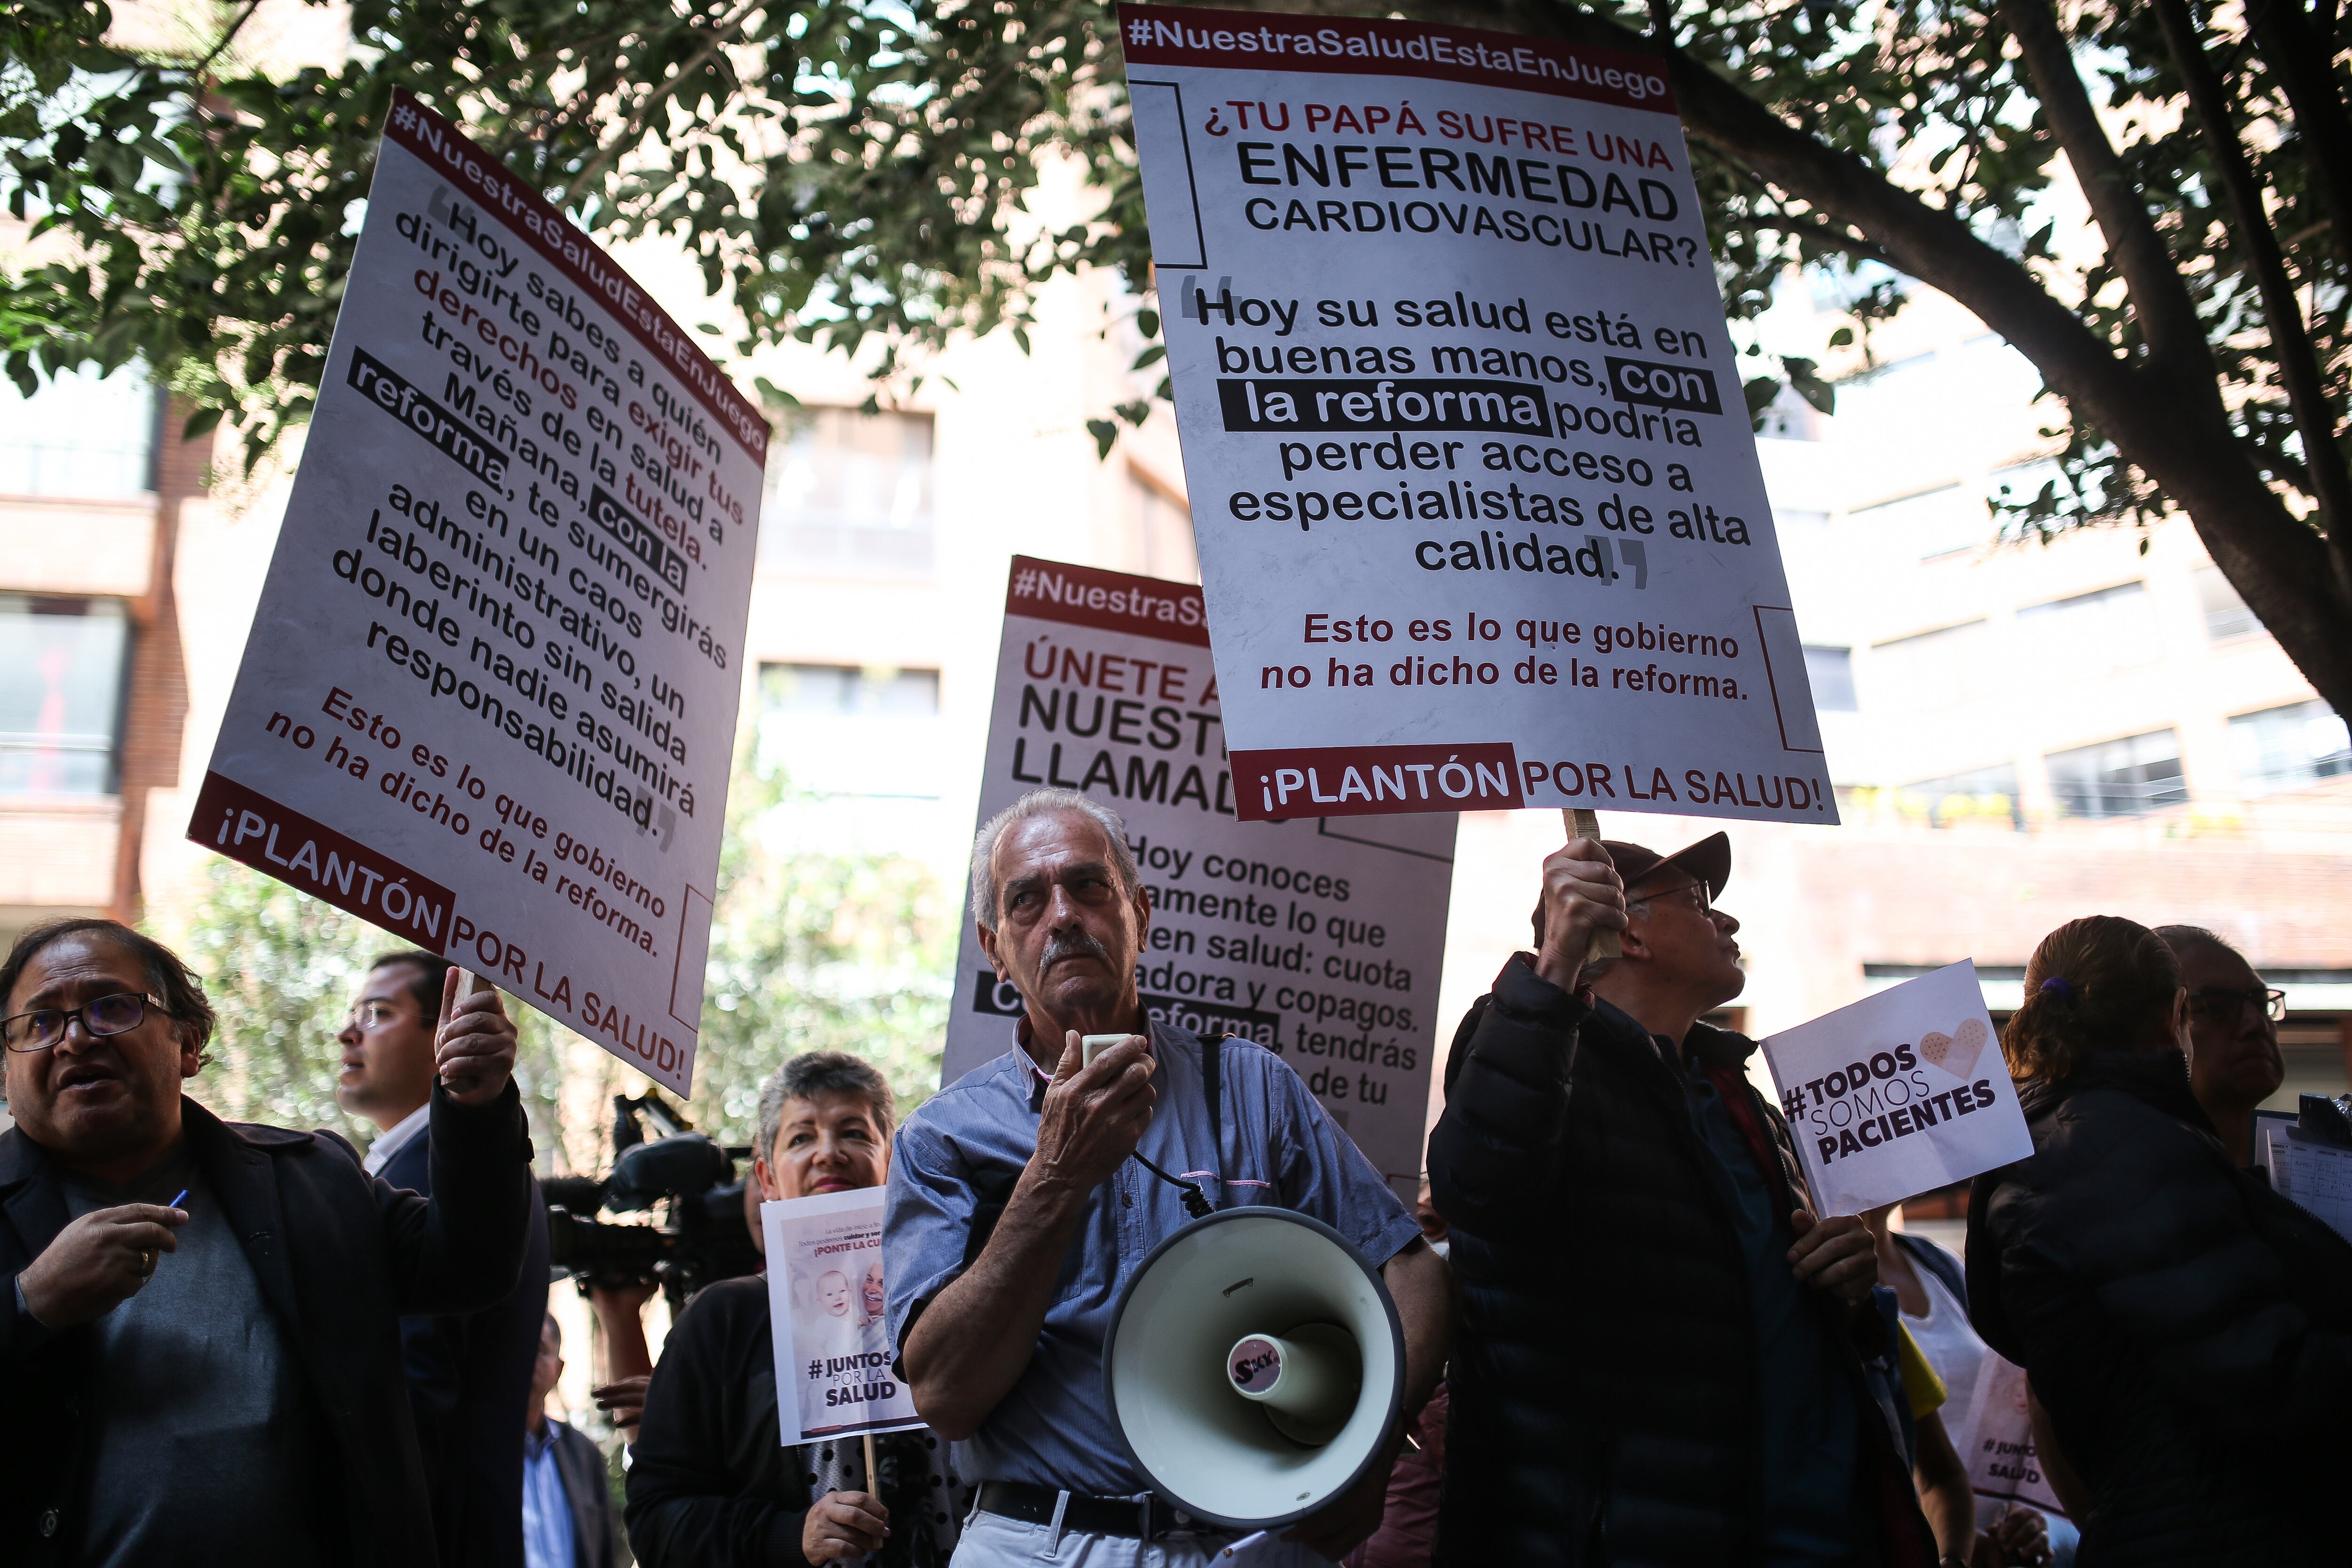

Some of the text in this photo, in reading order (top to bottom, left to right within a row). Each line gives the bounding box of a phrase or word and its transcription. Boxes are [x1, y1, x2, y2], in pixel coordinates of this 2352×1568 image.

[1128, 19, 1665, 98] #NuestraSaludEstaEnJuego
[1205, 101, 1673, 171] ¿TU PAPÁ SUFRE UNA
[1237, 142, 1678, 221] ENFERMEDAD
[1245, 198, 1697, 268] CARDIOVASCULAR?
[394, 104, 765, 452] #NuestraSaludEstaEnJuego
[449, 203, 721, 464] Hoy sabes a quién
[1197, 288, 1707, 358] Hoy su salud está en
[396, 213, 744, 525] dirigirte para exigir tus
[1216, 336, 1706, 402] buenas manos, con
[414, 270, 723, 546] derechos en salud a
[422, 311, 707, 571] través de la tutela.
[1246, 382, 1702, 447] la reforma podría
[445, 372, 683, 588] Mañana, con la
[1280, 432, 1693, 493] perder acceso a
[357, 363, 727, 670] reforma, te sumergirás
[1229, 480, 1751, 546] especialistas de alta
[466, 491, 642, 639] en un caos
[1415, 531, 1619, 581] calidad.
[389, 484, 685, 720] administrativo, un
[1014, 568, 1210, 628] #NuestraS
[367, 509, 686, 769] laberinto sin salida
[1024, 635, 1187, 702] ÚNETE
[1304, 612, 1739, 658] Esto es lo que gobierno
[333, 549, 695, 818] donde nadie asumirá
[1261, 655, 1747, 700] no ha dicho de la reforma.
[367, 621, 657, 836] responsabilidad.
[1018, 684, 1227, 761] NUEST
[322, 686, 665, 918] Esto es lo que gobierno
[1011, 737, 1287, 823] LLAMAD
[1260, 755, 1824, 812] ¡PLANTÓN POR LA SALUD!
[265, 711, 657, 957] no ha dicho de la reforma.
[1125, 832, 1350, 901] Hoy conoces
[219, 808, 686, 1081] ¡PLANTÓN POR LA SALUD!
[1147, 884, 1385, 948] amente lo que
[1151, 926, 1411, 992] en salud: cuota
[1135, 961, 1418, 1032] adora y copagos.
[1296, 1023, 1416, 1070] tendrás
[1310, 1067, 1388, 1104] de tu
[1783, 1043, 1917, 1123] #TODOS
[1811, 1070, 1930, 1136] SOMOS
[1817, 1079, 1995, 1165] PACIENTES
[814, 1243, 851, 1258] ¡PONTE
[853, 1241, 866, 1250] LA
[826, 1381, 896, 1407] SALUD
[832, 1368, 886, 1387] POR LA
[1988, 1463, 2041, 1484] SALUD
